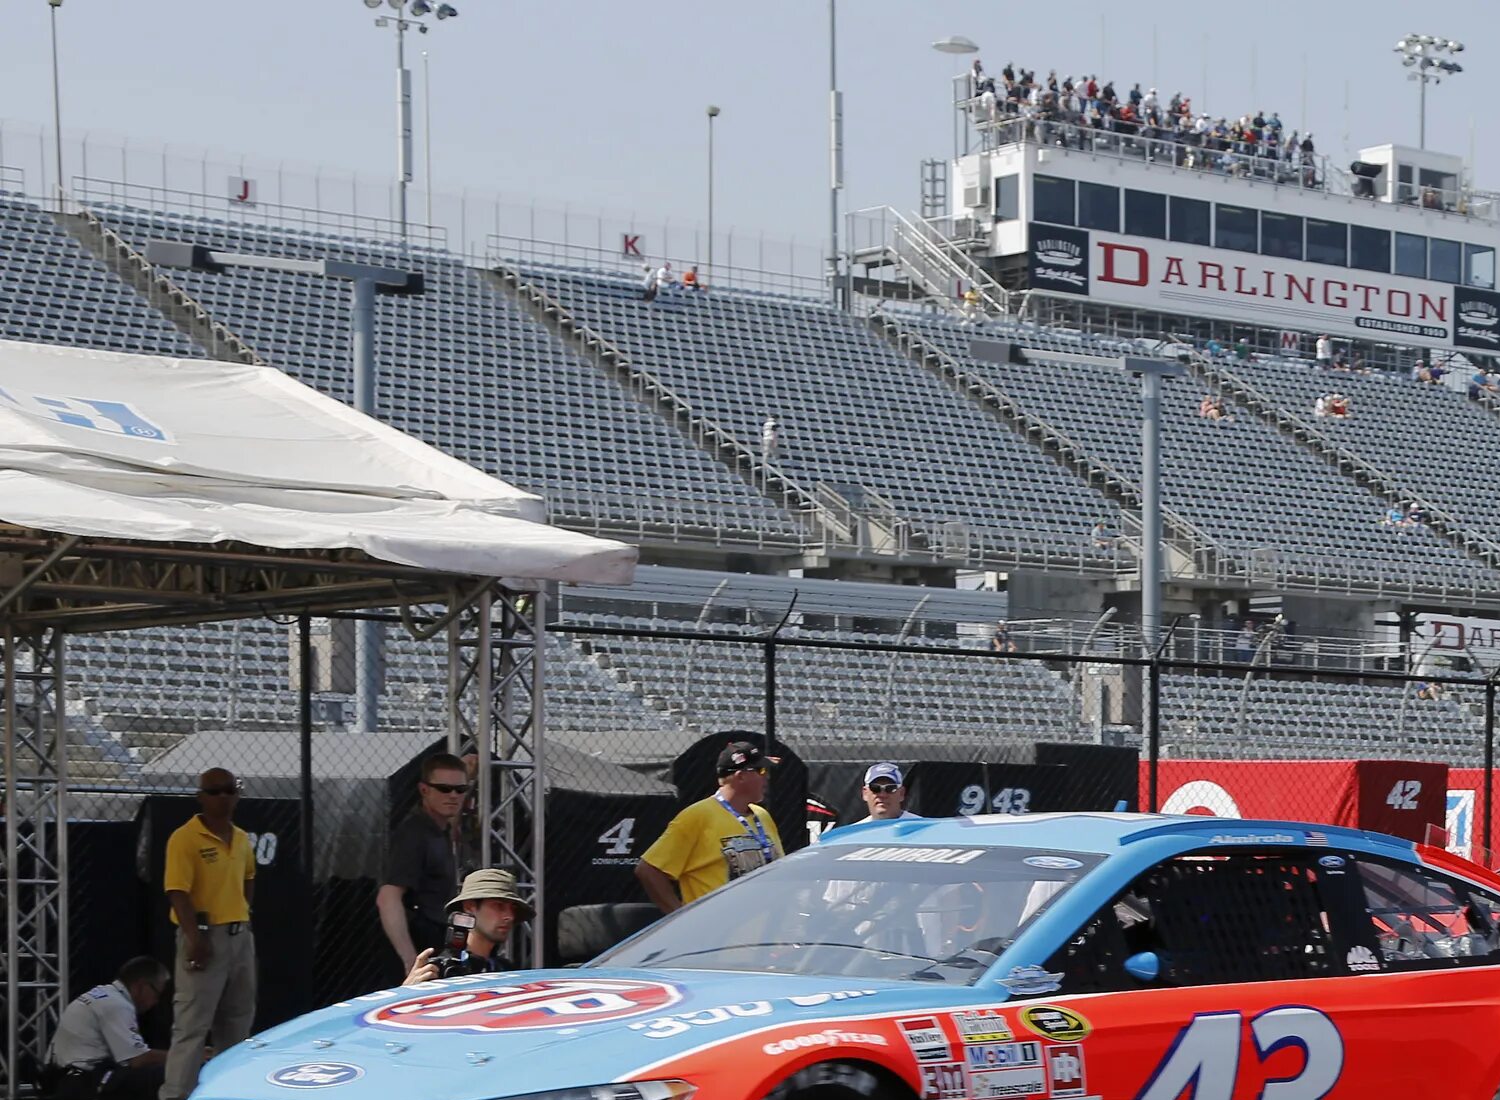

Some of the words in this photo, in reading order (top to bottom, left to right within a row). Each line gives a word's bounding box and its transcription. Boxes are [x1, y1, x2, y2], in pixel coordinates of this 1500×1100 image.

[237, 180, 249, 201] J
[624, 234, 640, 255] K
[957, 280, 966, 300] L
[1097, 242, 1448, 322] DARLINGTON
[1358, 318, 1421, 335] ESTABLISHED
[1282, 332, 1298, 349] M
[1386, 780, 1422, 809] 42
[598, 817, 636, 855] 4
[1210, 834, 1294, 844] Almirola
[835, 848, 986, 864] ALMIROLA
[761, 1029, 889, 1056] GOODYEAR
[970, 1045, 1019, 1065] Mobil
